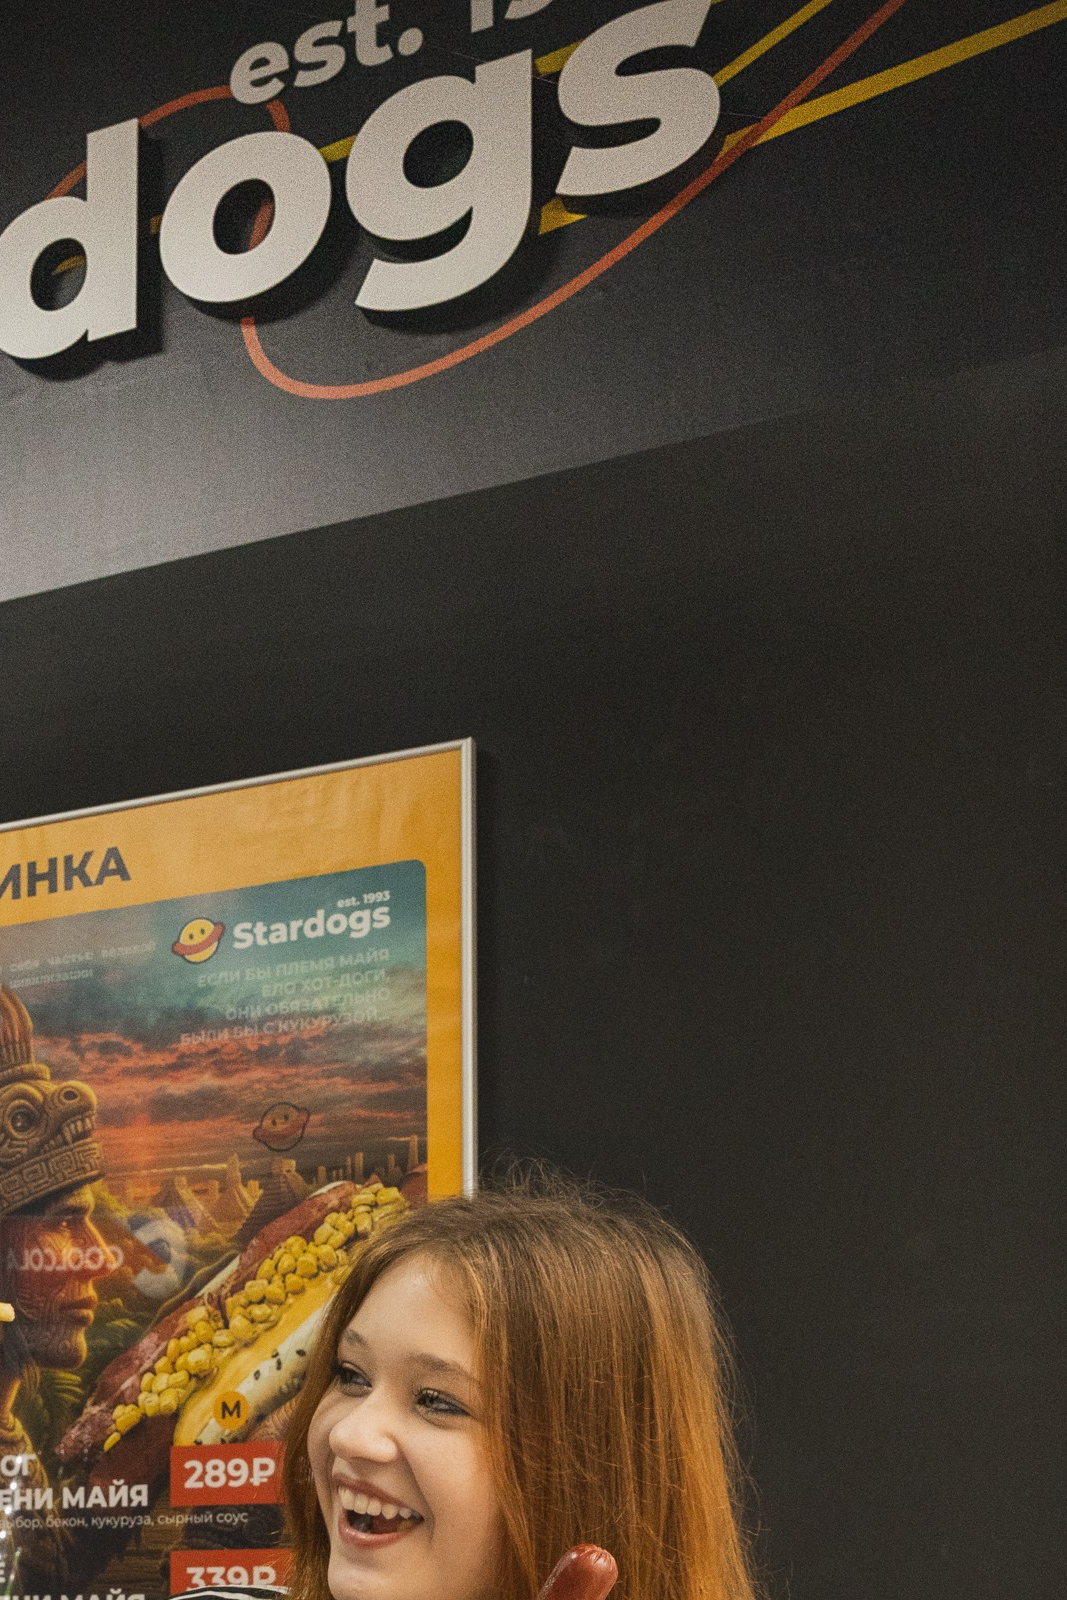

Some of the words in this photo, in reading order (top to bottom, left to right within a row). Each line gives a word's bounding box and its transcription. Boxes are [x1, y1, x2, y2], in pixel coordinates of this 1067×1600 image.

[229, 0, 424, 104] est.
[336, 896, 360, 909] est.
[362, 890, 391, 904] 1993
[232, 906, 392, 950] Stardogs
[197, 970, 241, 988] ЕСЛИ
[245, 966, 271, 982] БЫ
[276, 956, 335, 978] ПЛЕМЯ
[339, 948, 391, 968] МАЙЯ
[225, 1004, 262, 1022] ОНИ
[264, 988, 391, 1015] ОБЯЗАТЕЛЬНО
[262, 982, 299, 998] ЕЛО
[180, 1028, 232, 1045] БЫЛИ
[234, 1023, 258, 1039] БЫ
[221, 1402, 241, 1420] M
[183, 1457, 276, 1489] 289₽
[62, 1478, 149, 1509] МАЙЯ
[45, 1515, 89, 1532] бекон,
[91, 1515, 155, 1532] кукуруза,
[157, 1510, 214, 1528] сырный
[215, 1512, 250, 1528] соус
